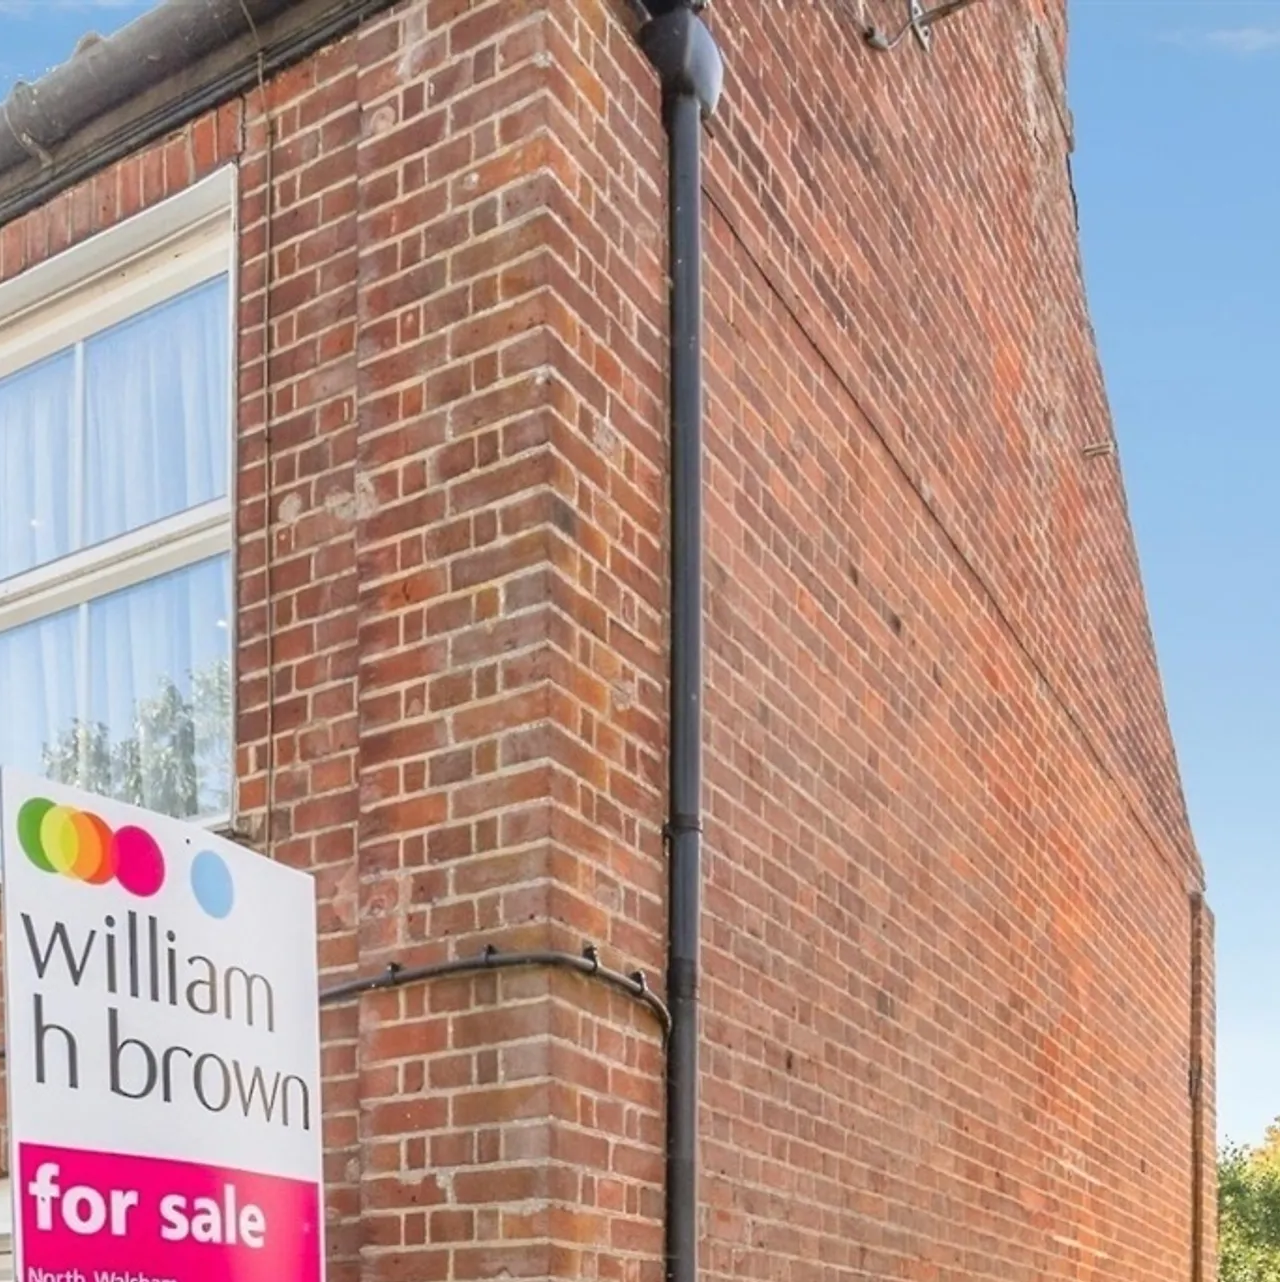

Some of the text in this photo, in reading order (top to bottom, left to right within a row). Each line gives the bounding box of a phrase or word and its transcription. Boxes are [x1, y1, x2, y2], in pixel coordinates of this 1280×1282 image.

[20, 909, 274, 1033] william
[33, 992, 310, 1130] h brown
[28, 1162, 266, 1248] for sale
